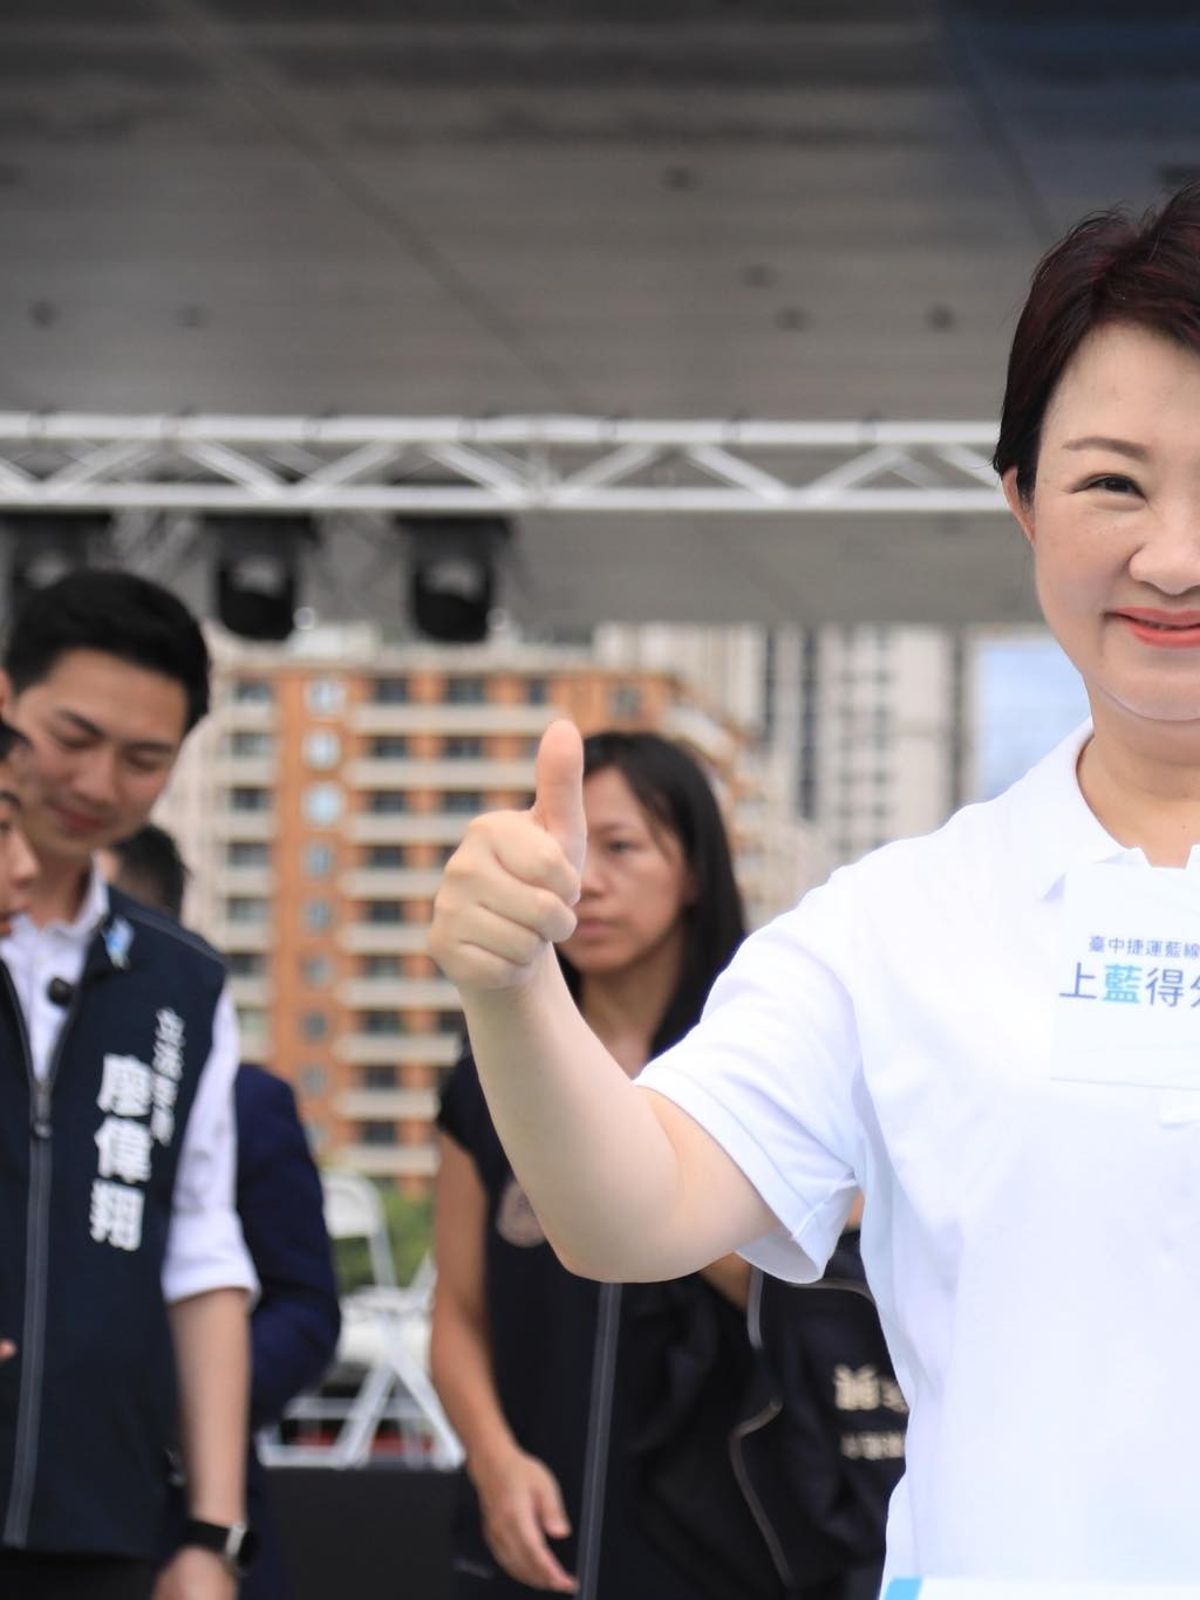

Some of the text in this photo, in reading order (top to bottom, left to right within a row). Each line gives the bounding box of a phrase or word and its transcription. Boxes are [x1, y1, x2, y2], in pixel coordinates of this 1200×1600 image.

[1089, 935, 1200, 959] 臺中捷運藍線
